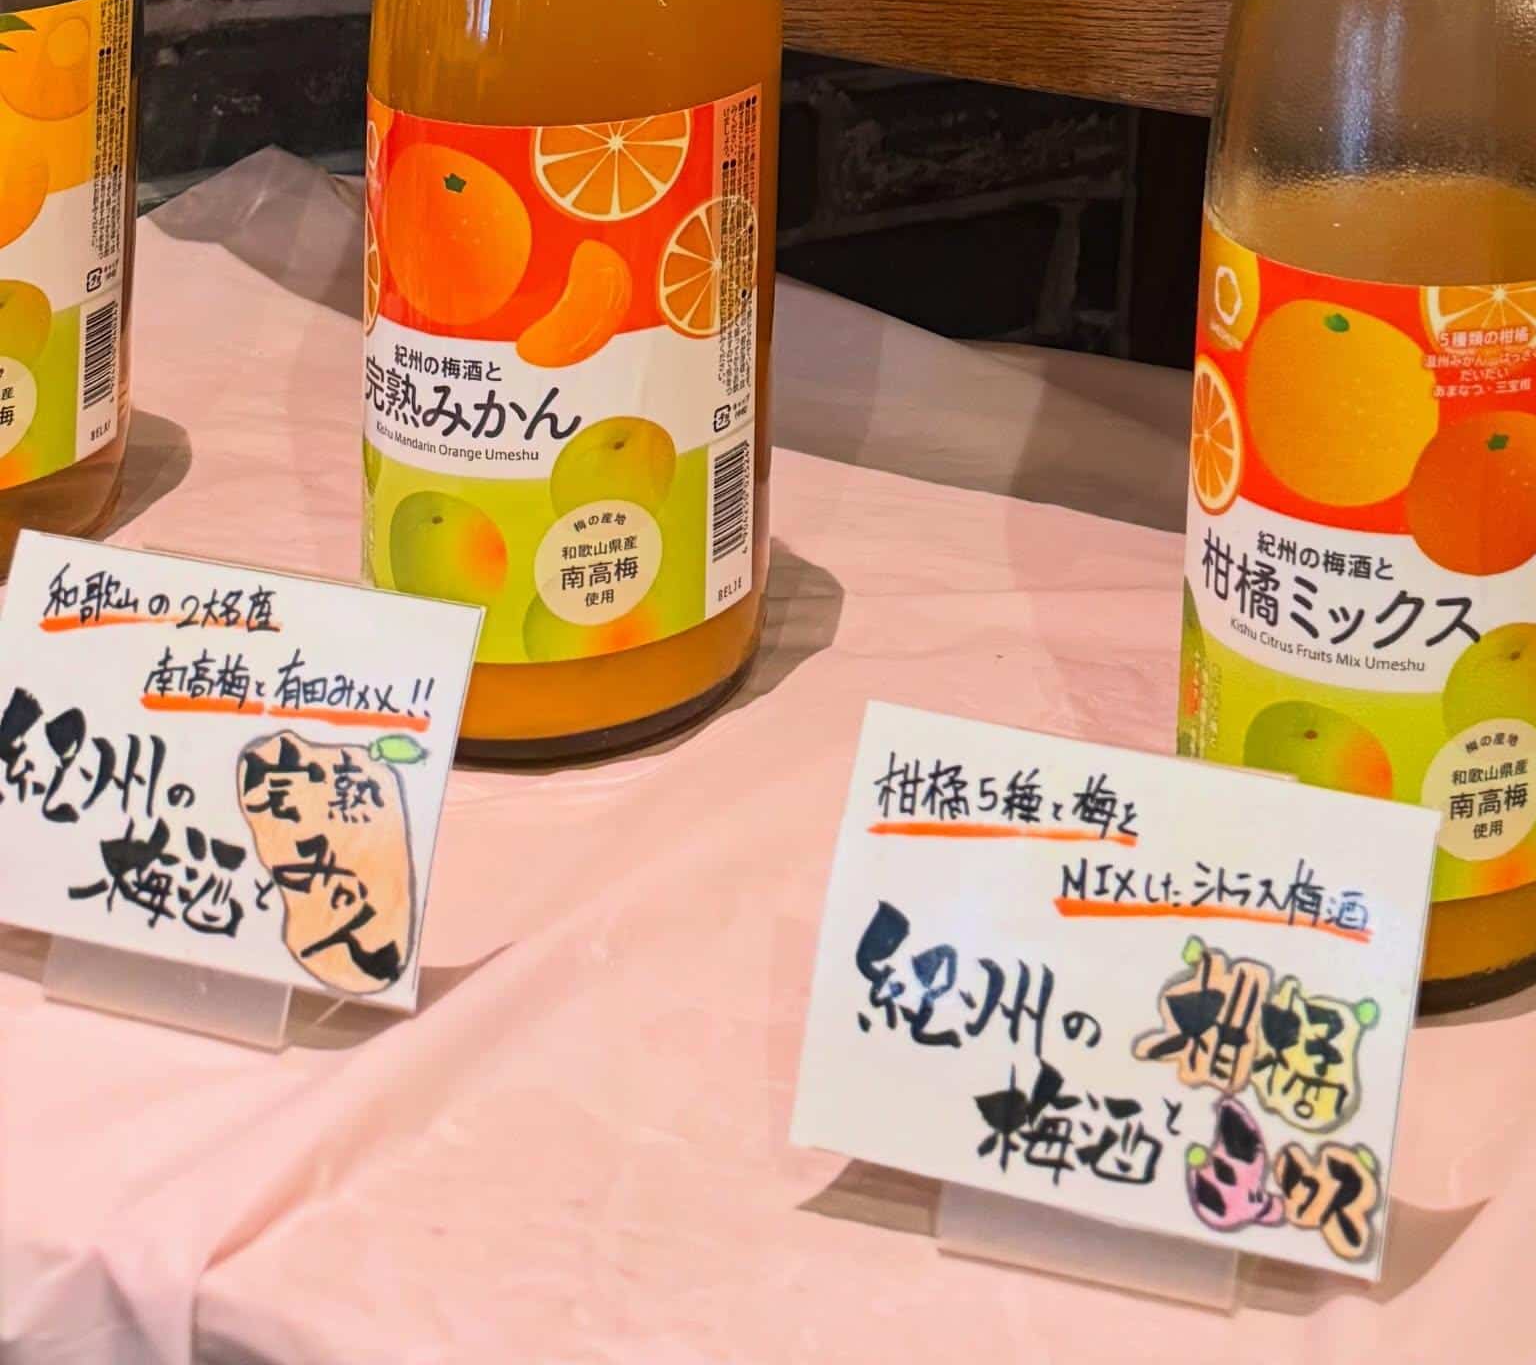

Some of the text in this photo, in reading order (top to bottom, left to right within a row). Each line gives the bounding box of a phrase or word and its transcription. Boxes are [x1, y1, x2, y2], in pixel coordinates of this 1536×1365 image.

[394, 343, 502, 383] 紀州の梅酒と
[394, 432, 437, 454] Mandarin
[438, 443, 483, 461] Orange
[485, 447, 539, 462] Umeshu
[561, 534, 639, 562] 和歌山県産
[1256, 529, 1395, 582] 紀州の梅酒と
[559, 556, 640, 592] 南高梅
[1201, 526, 1482, 650] 柑橘ミックス
[584, 588, 616, 607] 使用
[1229, 617, 1426, 672] Kishu Citrus Fruits Mix Umeshu
[1451, 758, 1529, 786] 和歌山県産
[1449, 781, 1529, 820] 南高梅
[1472, 819, 1504, 841] 使用
[855, 900, 1102, 1054] 紀州の
